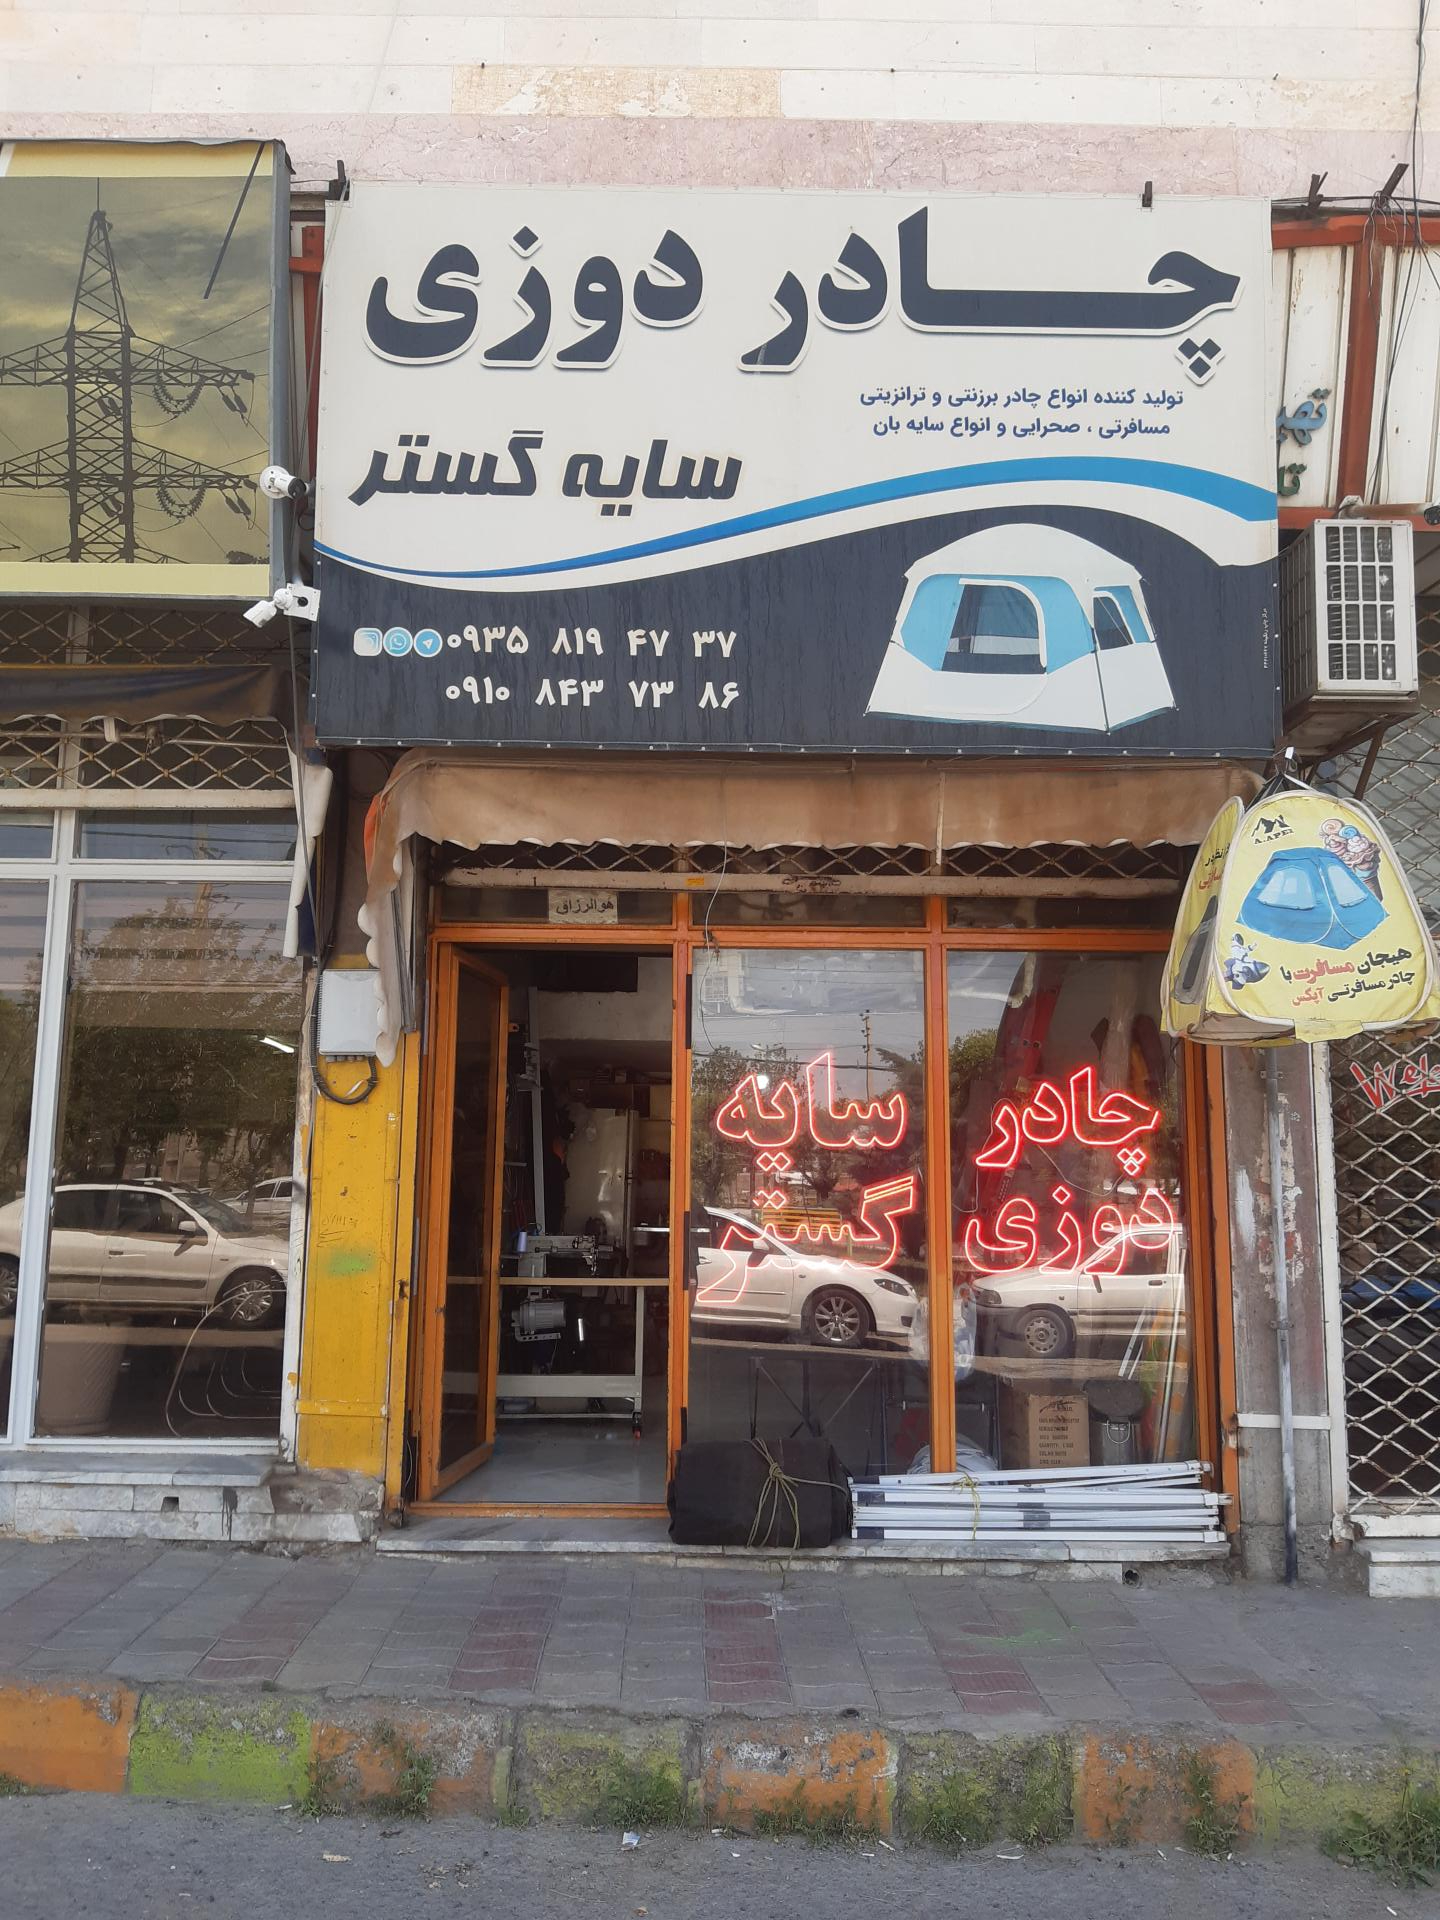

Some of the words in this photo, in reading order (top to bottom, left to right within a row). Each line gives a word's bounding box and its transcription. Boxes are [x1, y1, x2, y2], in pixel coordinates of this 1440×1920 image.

[365, 226, 703, 364] دوزی
[739, 206, 1242, 380] چادر
[860, 386, 926, 407] ترانزیتی
[932, 392, 942, 407] و
[948, 387, 998, 408] برزنتی
[1003, 388, 1041, 409] چادر
[1048, 388, 1087, 406] انواع
[1094, 389, 1136, 405] کننده
[1143, 390, 1184, 409] تولید
[873, 416, 900, 437] بان
[906, 416, 944, 434] سایه
[950, 416, 991, 438] انواع
[996, 423, 1007, 438] و
[1013, 418, 1080, 438] صحرایی
[1099, 418, 1170, 439] مسافرتی
[348, 430, 543, 506] گستر
[562, 440, 742, 516] سایه
[447, 625, 529, 653] ۰۹۳۵
[552, 628, 603, 655] ۸۱۹
[627, 629, 669, 657] ۴۷
[693, 630, 737, 657] ۳۷
[446, 676, 510, 704] ۰۹۱۰
[535, 679, 604, 706] ۸۴۳
[629, 681, 674, 708] ۷۳
[699, 682, 740, 709] ۸۶
[1293, 959, 1355, 984] مسافرت
[1357, 947, 1413, 975] هیجان
[1280, 966, 1292, 984] با
[1387, 970, 1415, 990] چادر
[716, 1052, 907, 1173] سایه
[975, 1066, 1161, 1176] چادر
[695, 1174, 916, 1303] گستر
[963, 1184, 1176, 1276] دوزی
